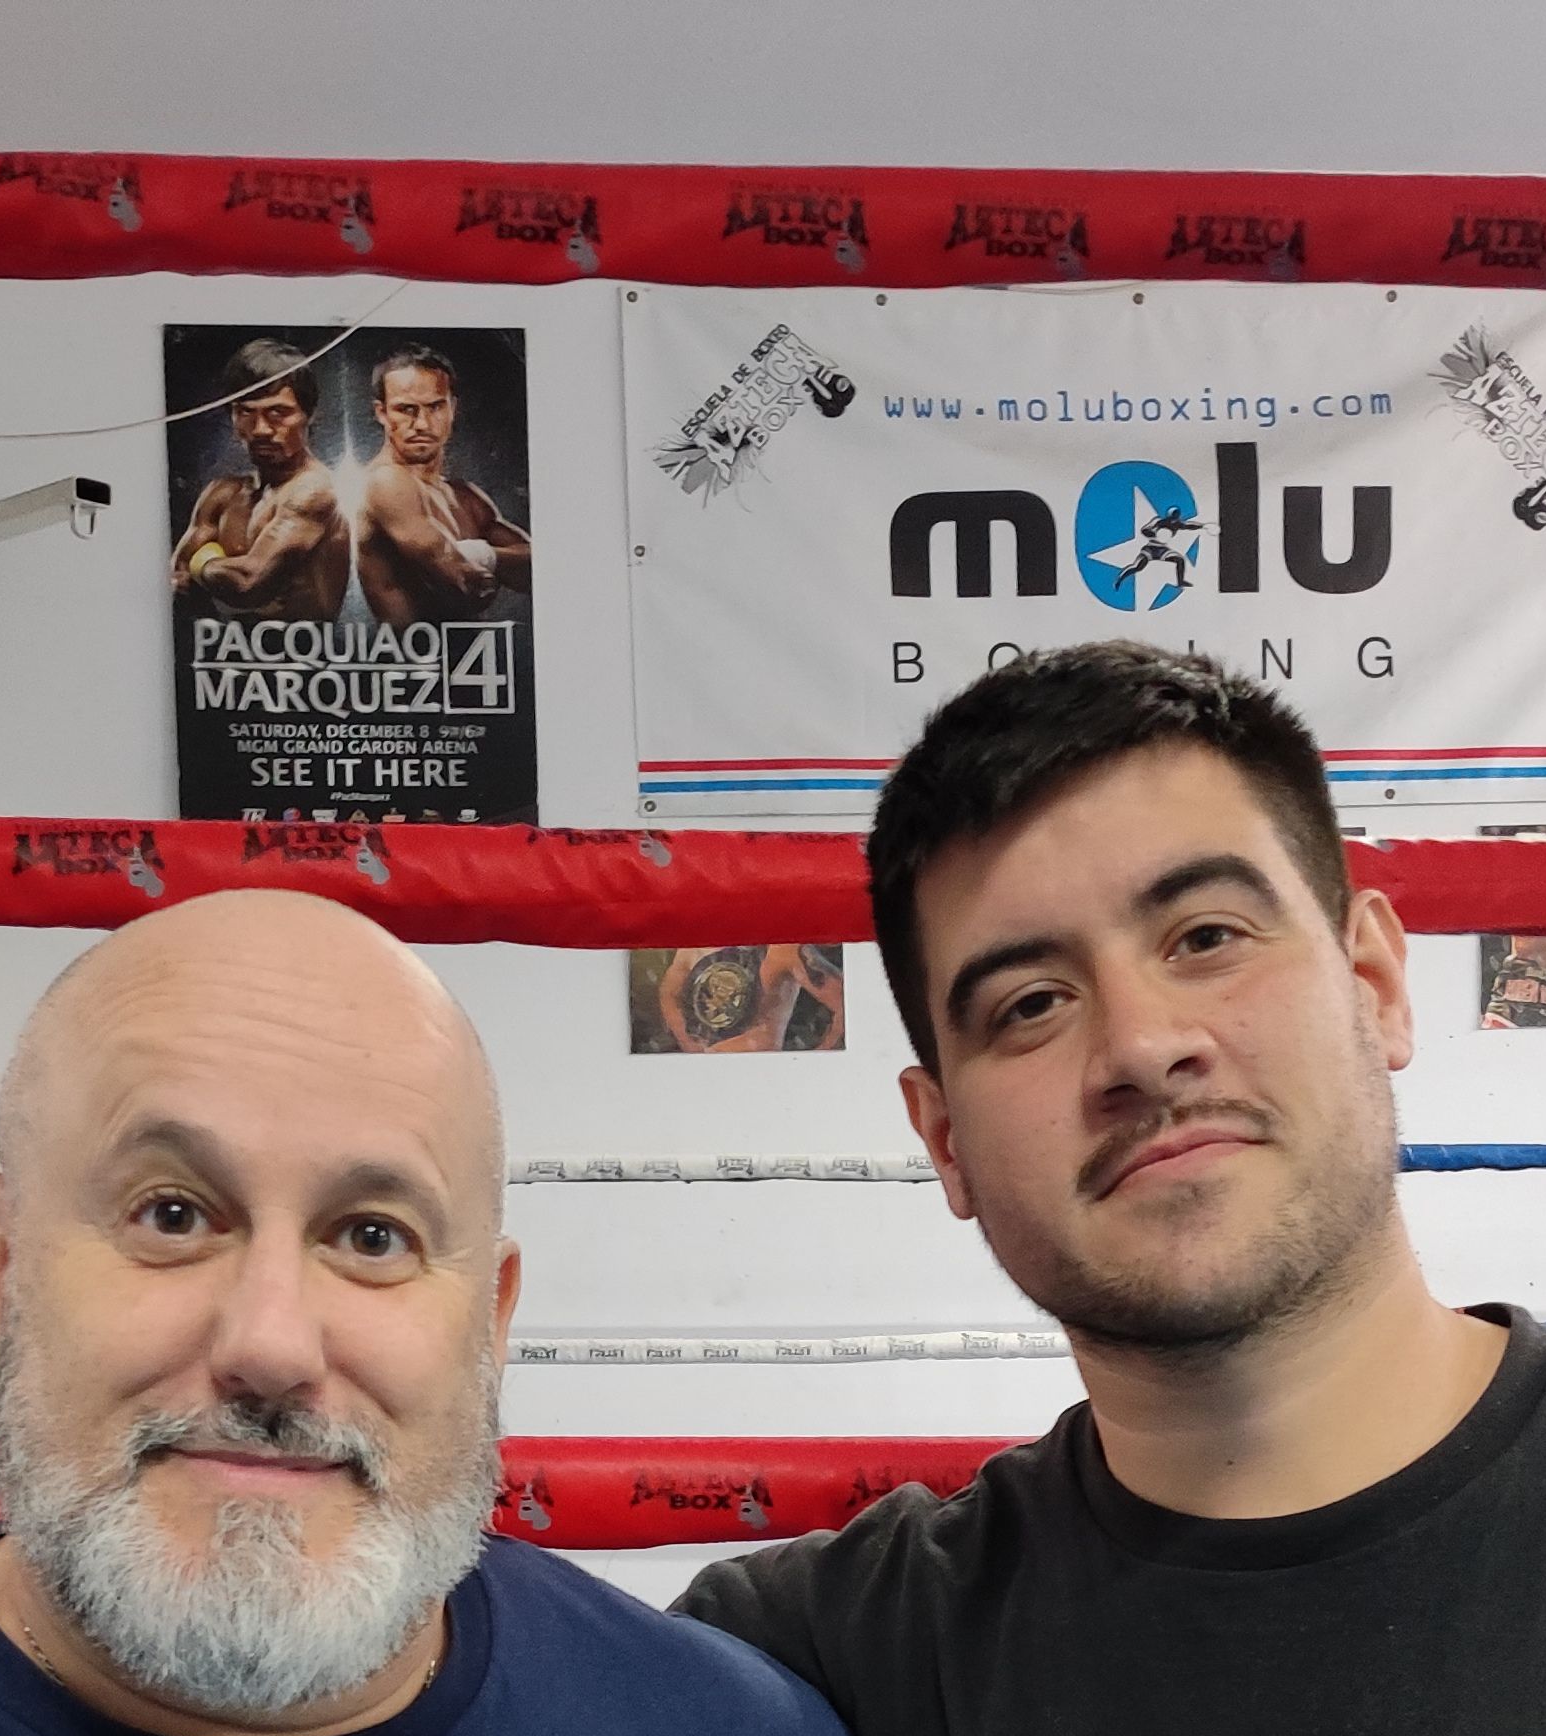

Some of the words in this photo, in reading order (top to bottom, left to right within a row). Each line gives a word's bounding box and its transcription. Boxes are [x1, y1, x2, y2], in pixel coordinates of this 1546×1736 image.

[731, 363, 752, 385] DE
[746, 385, 805, 450] BOX
[883, 387, 1394, 428] www.moluboxing.com
[1482, 417, 1543, 479] BOX
[890, 441, 1394, 614] molu
[193, 618, 441, 667] PACQUIAO
[450, 630, 508, 707] 4
[194, 669, 442, 719] MARQUEZ
[228, 723, 322, 741] SATURDAY,
[326, 724, 414, 739] DECEMBER
[419, 724, 430, 739] 8
[236, 739, 278, 753] MGM
[282, 740, 343, 754] GRAND
[347, 740, 417, 755] GARDEN
[422, 741, 479, 755] ARENA
[250, 758, 314, 787] SEE
[326, 758, 362, 787] IT
[374, 758, 470, 787] HERE
[669, 1493, 732, 1511] BOX
